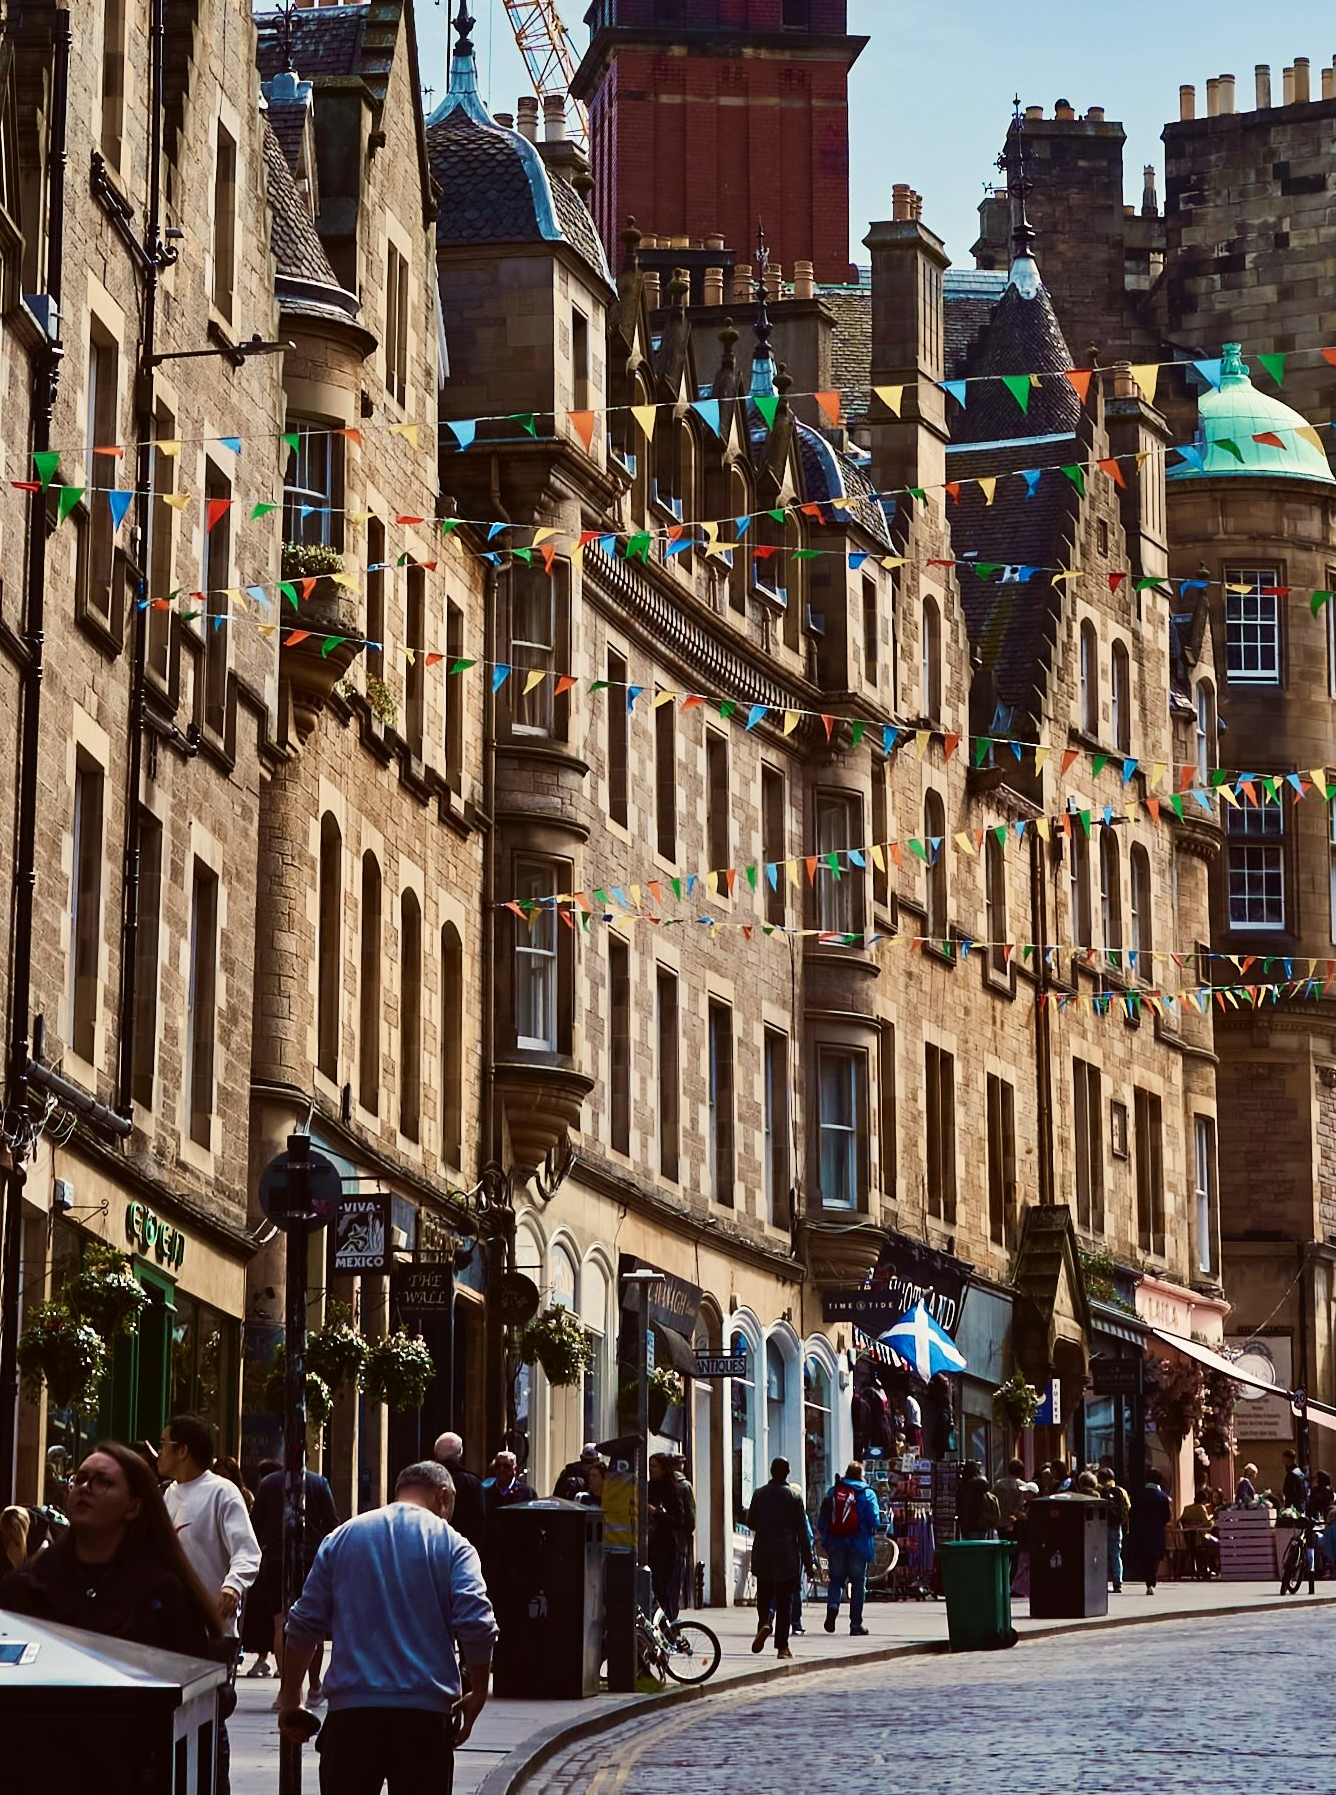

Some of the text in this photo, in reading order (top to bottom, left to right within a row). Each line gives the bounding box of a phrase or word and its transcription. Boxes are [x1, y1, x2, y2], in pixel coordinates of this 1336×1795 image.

[343, 1202, 376, 1213] VIVA
[335, 1256, 385, 1269] MEXICO
[408, 1270, 443, 1287] THE
[403, 1290, 446, 1305] WALL
[827, 1302, 853, 1310] TIME
[868, 1301, 894, 1309] TIDE
[1294, 1392, 1306, 1404] 20
